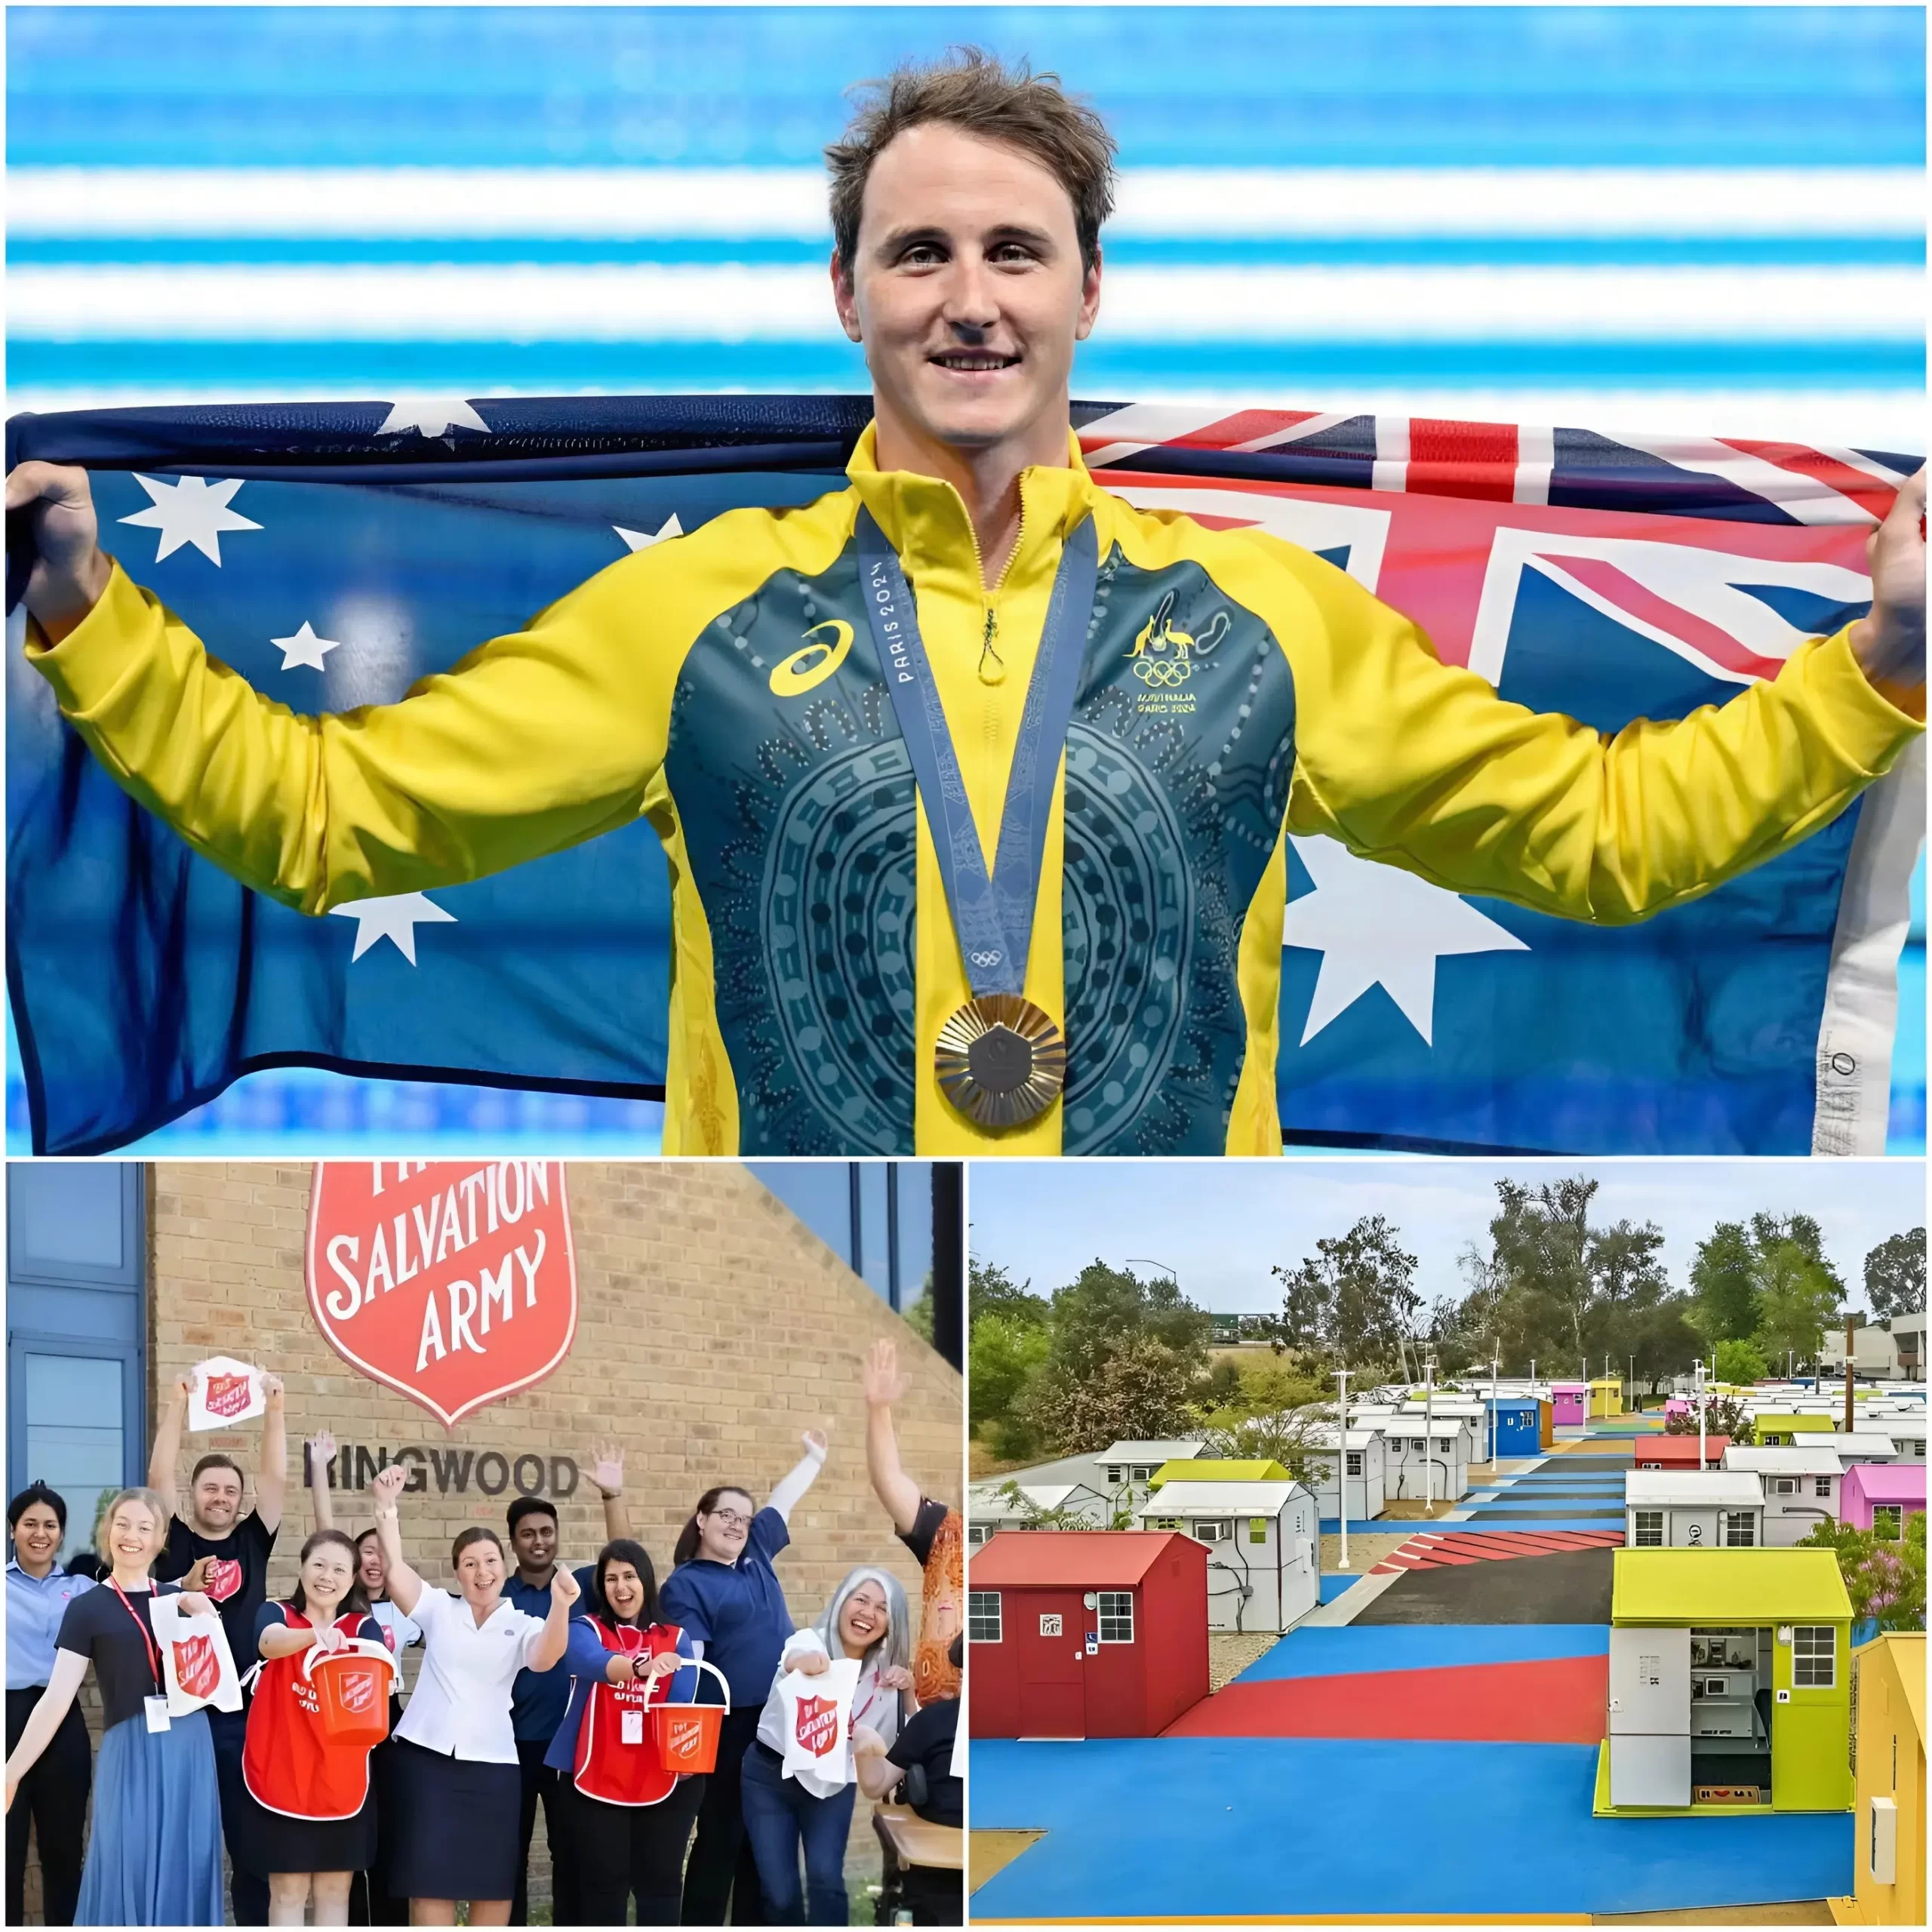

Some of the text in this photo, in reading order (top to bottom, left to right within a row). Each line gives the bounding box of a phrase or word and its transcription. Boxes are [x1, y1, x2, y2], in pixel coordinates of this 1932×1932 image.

[870, 561, 914, 683] PARIS 2024
[326, 1162, 549, 1320] SALVATION
[415, 1229, 546, 1373] ARMY
